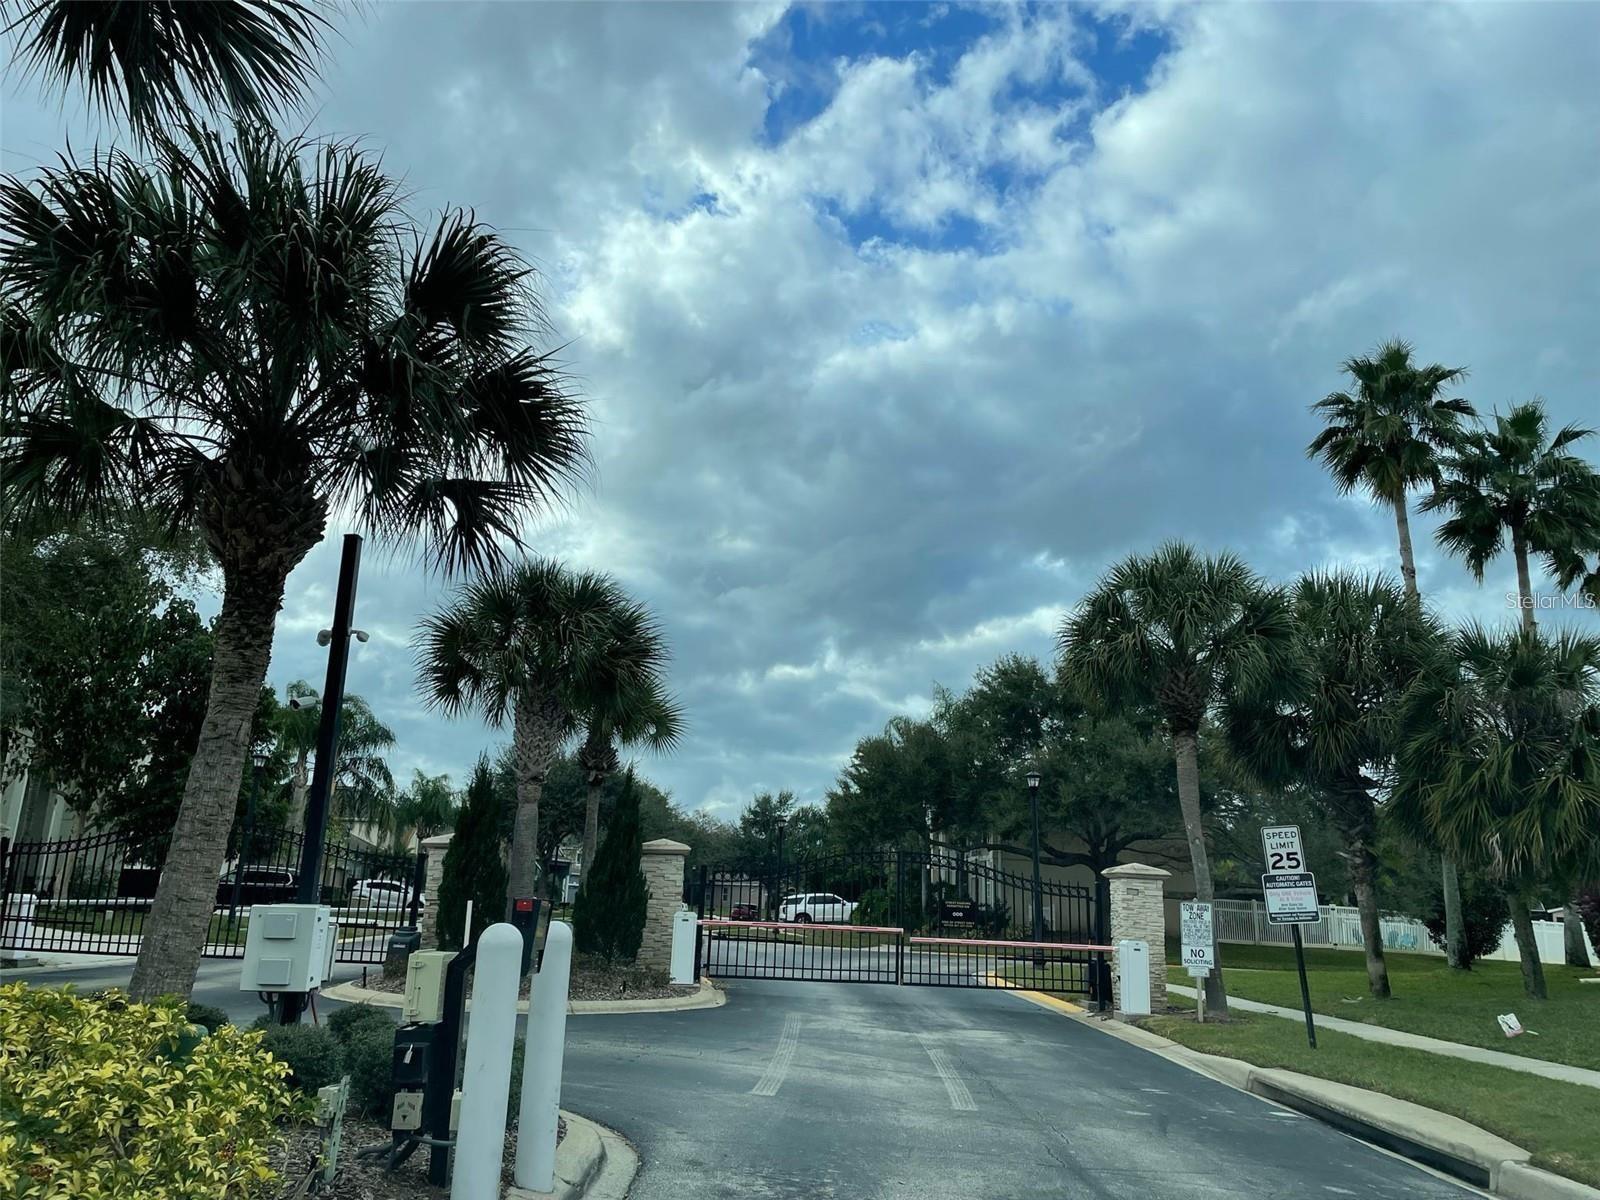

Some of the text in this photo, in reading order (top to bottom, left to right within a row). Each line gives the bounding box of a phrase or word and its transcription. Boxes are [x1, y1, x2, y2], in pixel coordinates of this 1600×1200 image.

[1266, 831, 1297, 839] SPEED
[1270, 841, 1295, 849] LIMIT
[1270, 852, 1301, 870] 25
[1182, 904, 1194, 912] TOW
[1189, 912, 1204, 920] ZONE
[1190, 948, 1205, 958] NO
